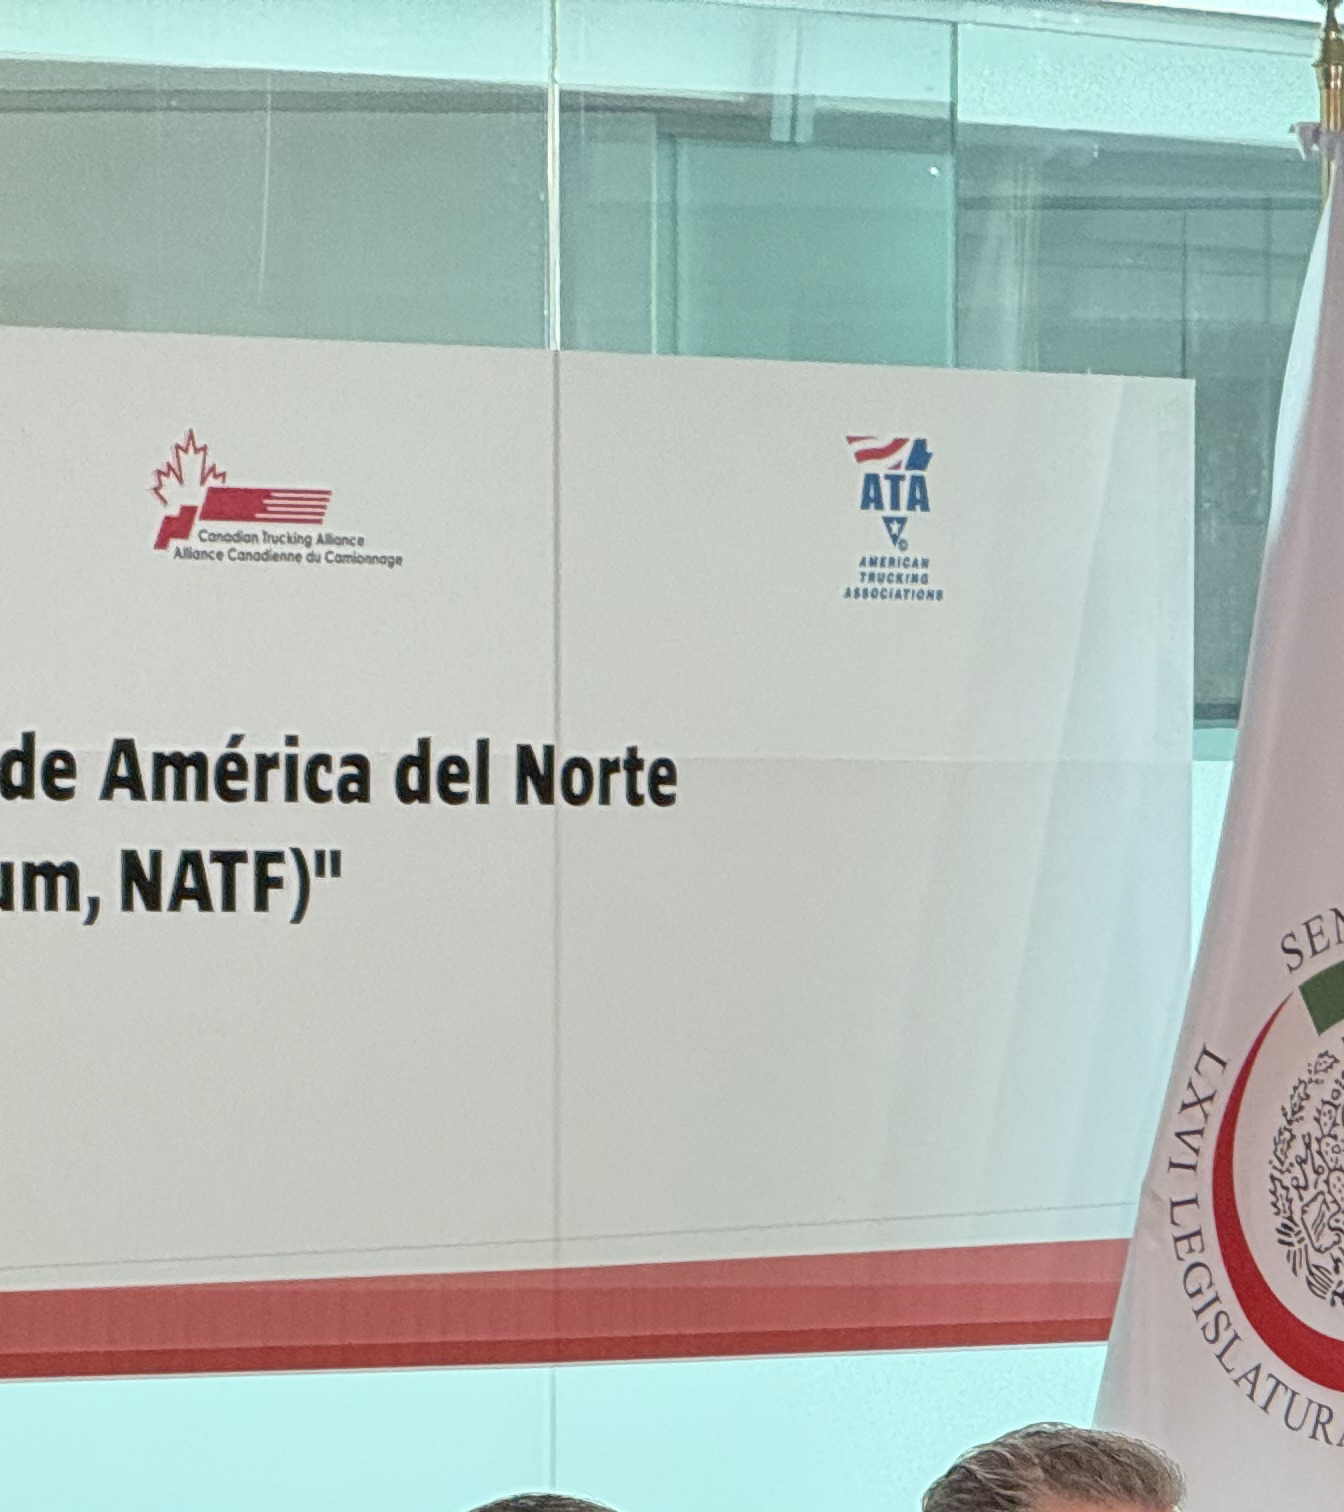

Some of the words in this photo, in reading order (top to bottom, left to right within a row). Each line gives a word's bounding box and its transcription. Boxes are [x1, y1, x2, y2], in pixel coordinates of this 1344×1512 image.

[860, 473, 930, 513] ATA
[197, 529, 259, 544] Canadian
[262, 530, 313, 548] Trucking
[316, 532, 365, 548] Alliance
[173, 546, 224, 562] Alliance
[227, 547, 302, 564] Canadienne
[305, 550, 322, 565] du
[324, 550, 403, 569] Camionnage
[858, 555, 930, 569] AMERICAN
[859, 571, 930, 585] TRUCKING
[843, 587, 944, 602] ASSOCIATIONS
[0, 731, 77, 801] de
[99, 733, 372, 803] América
[394, 736, 490, 806] del
[515, 743, 678, 808] Norte
[119, 846, 342, 925] NATF)"
[1167, 1044, 1228, 1173] LXVI
